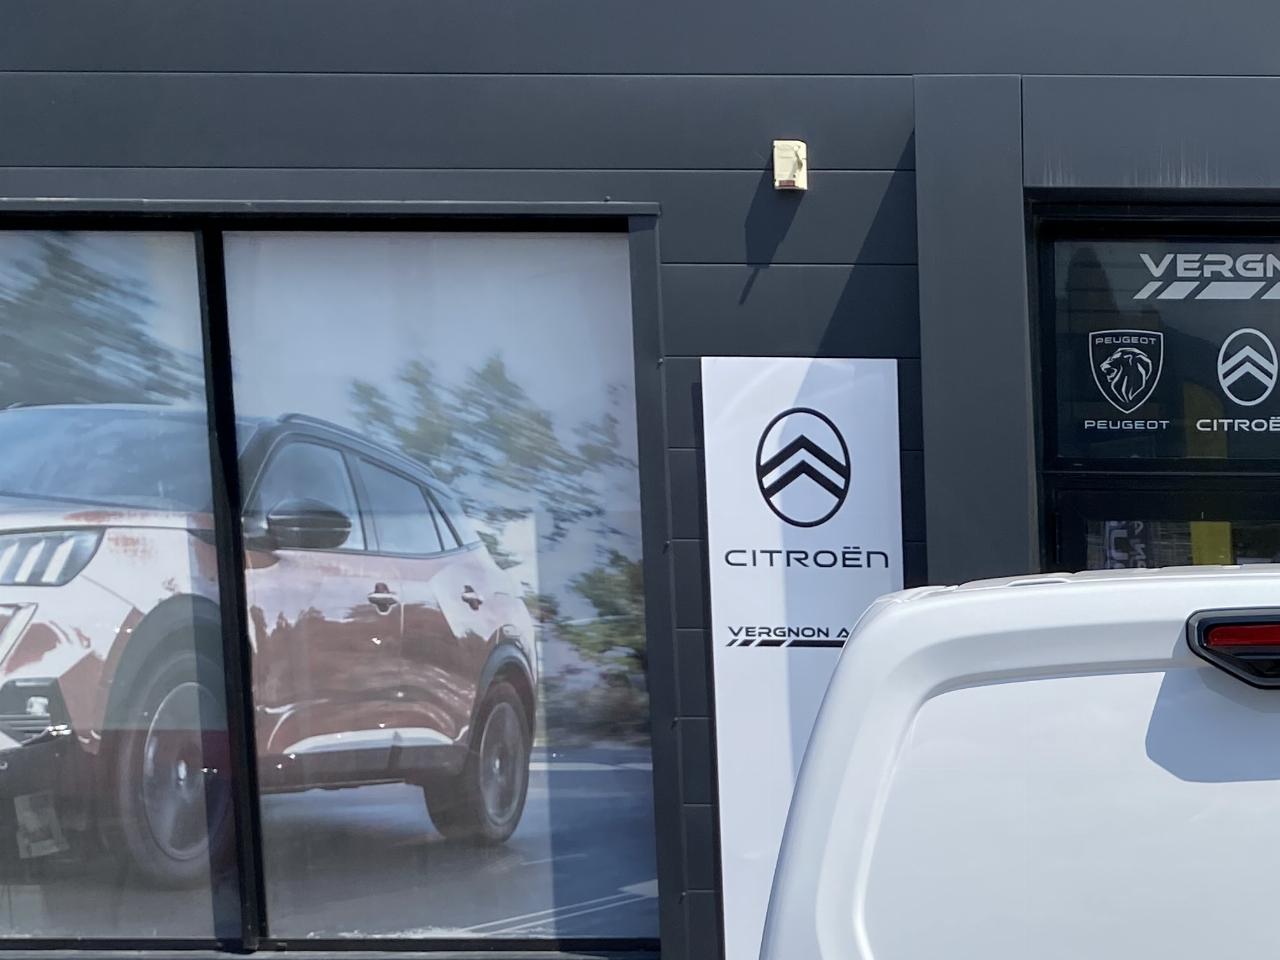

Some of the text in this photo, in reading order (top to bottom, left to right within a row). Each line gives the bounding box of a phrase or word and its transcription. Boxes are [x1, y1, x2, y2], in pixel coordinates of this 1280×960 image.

[1095, 335, 1157, 346] PEUGEOT
[1084, 420, 1170, 430] PEUGEOT
[724, 546, 889, 568] CITROËN
[727, 626, 830, 638] VERGNON
